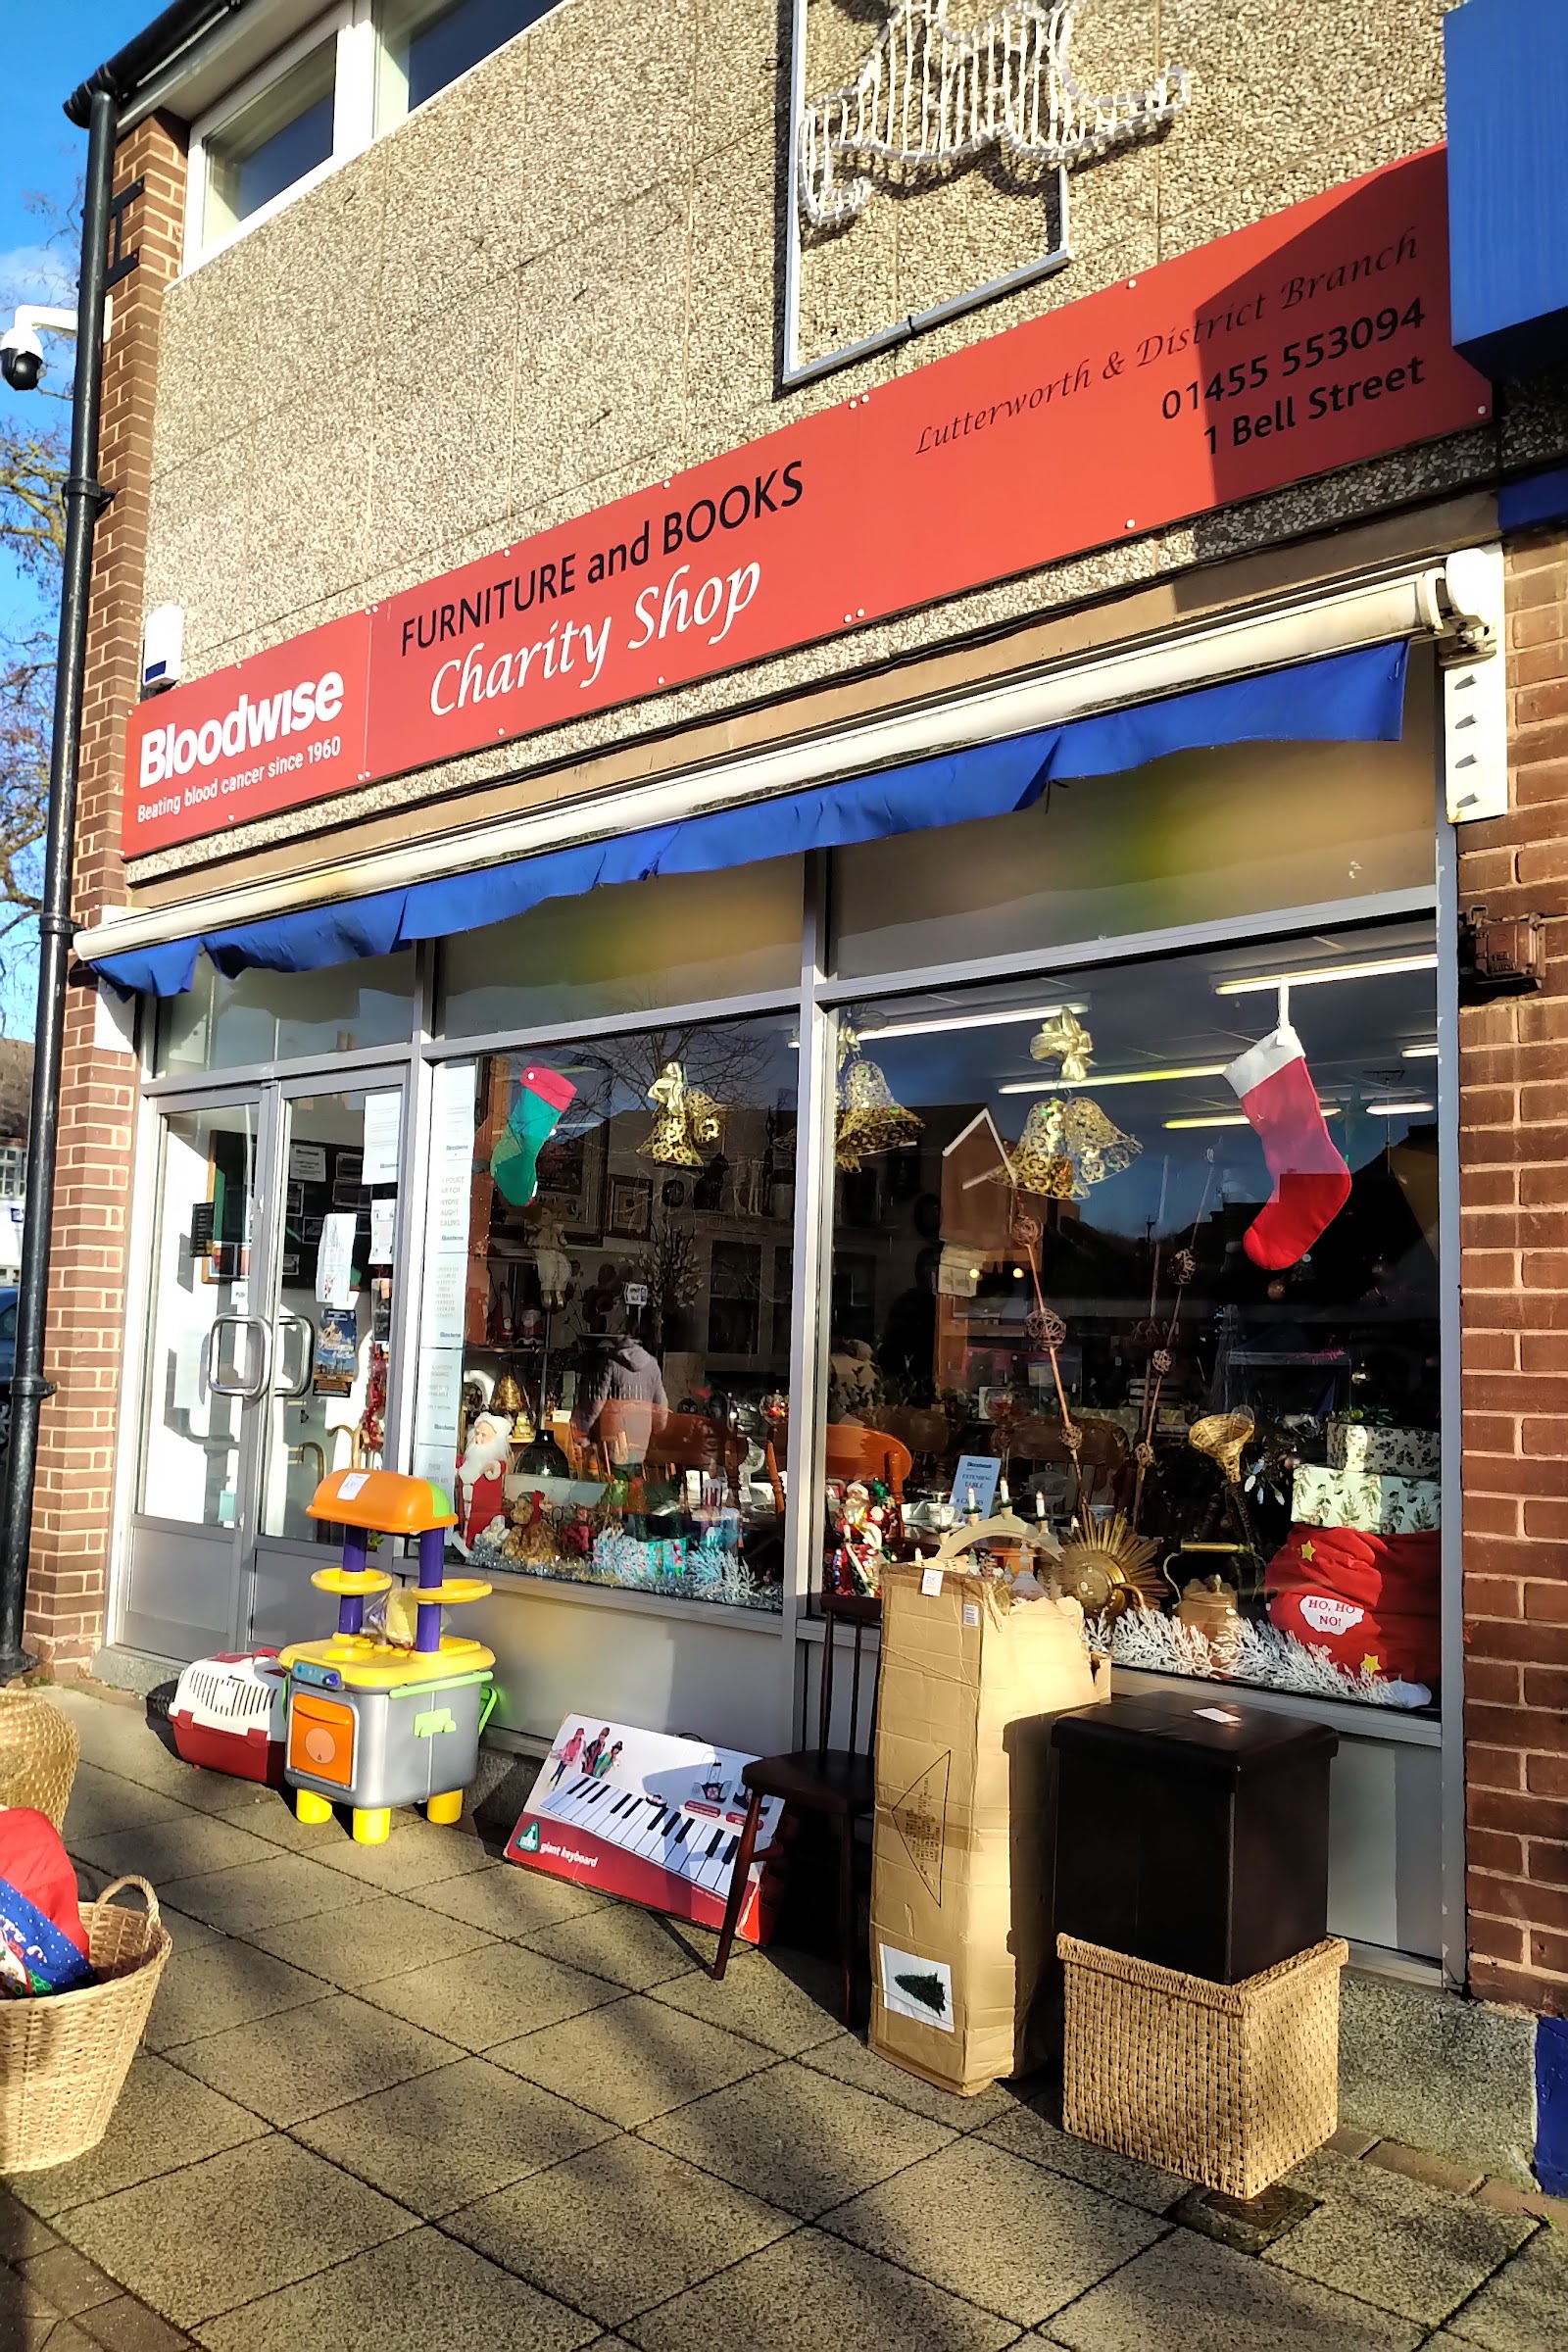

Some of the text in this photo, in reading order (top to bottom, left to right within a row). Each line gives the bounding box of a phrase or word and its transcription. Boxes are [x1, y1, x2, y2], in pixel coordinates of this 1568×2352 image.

[915, 225, 1418, 455] Lutterworth & District Branch
[1161, 297, 1425, 419] 01455 553094
[1204, 356, 1425, 455] 1 Bell Street
[401, 461, 804, 657] FURNITURE and BOOKS
[429, 562, 760, 716] Charity Shop
[139, 671, 344, 788] Bloodwise
[137, 736, 341, 823] Beating blood cancer since 1960
[961, 1473, 992, 1482] EXTENDING
[1308, 1598, 1355, 1614] HO, HO
[1319, 1615, 1342, 1627] NO!
[539, 1841, 561, 1856] giant
[561, 1846, 599, 1868] keyboard
